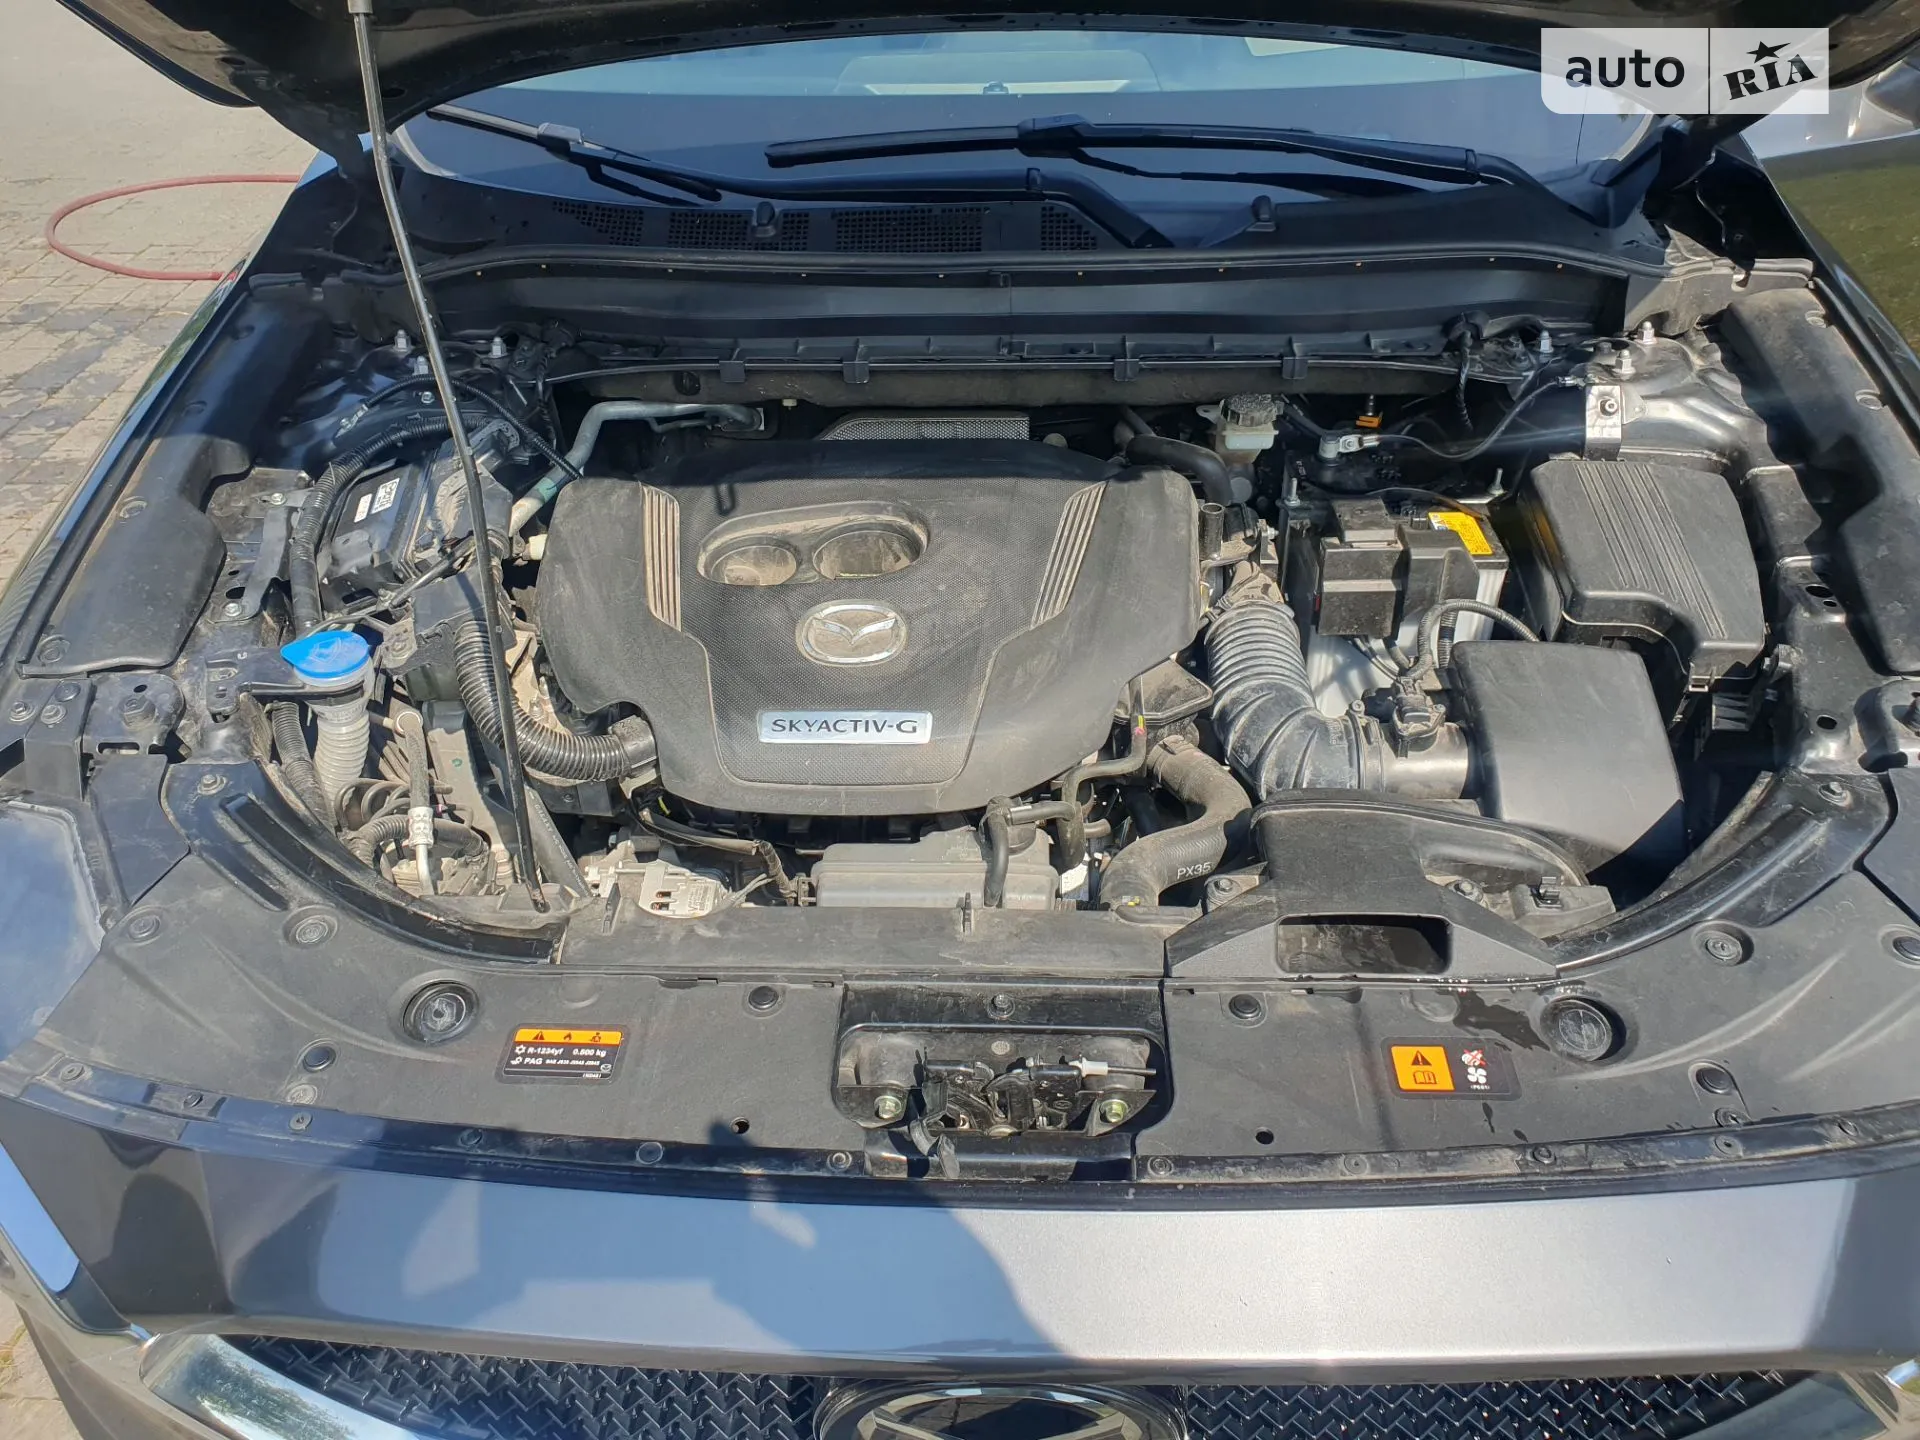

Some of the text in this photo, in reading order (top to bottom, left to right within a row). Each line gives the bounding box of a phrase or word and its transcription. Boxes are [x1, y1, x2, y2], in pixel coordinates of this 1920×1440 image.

[771, 719, 917, 733] SKYACTIV-G
[527, 1047, 564, 1056] R-1234yf
[595, 1049, 607, 1058] kg
